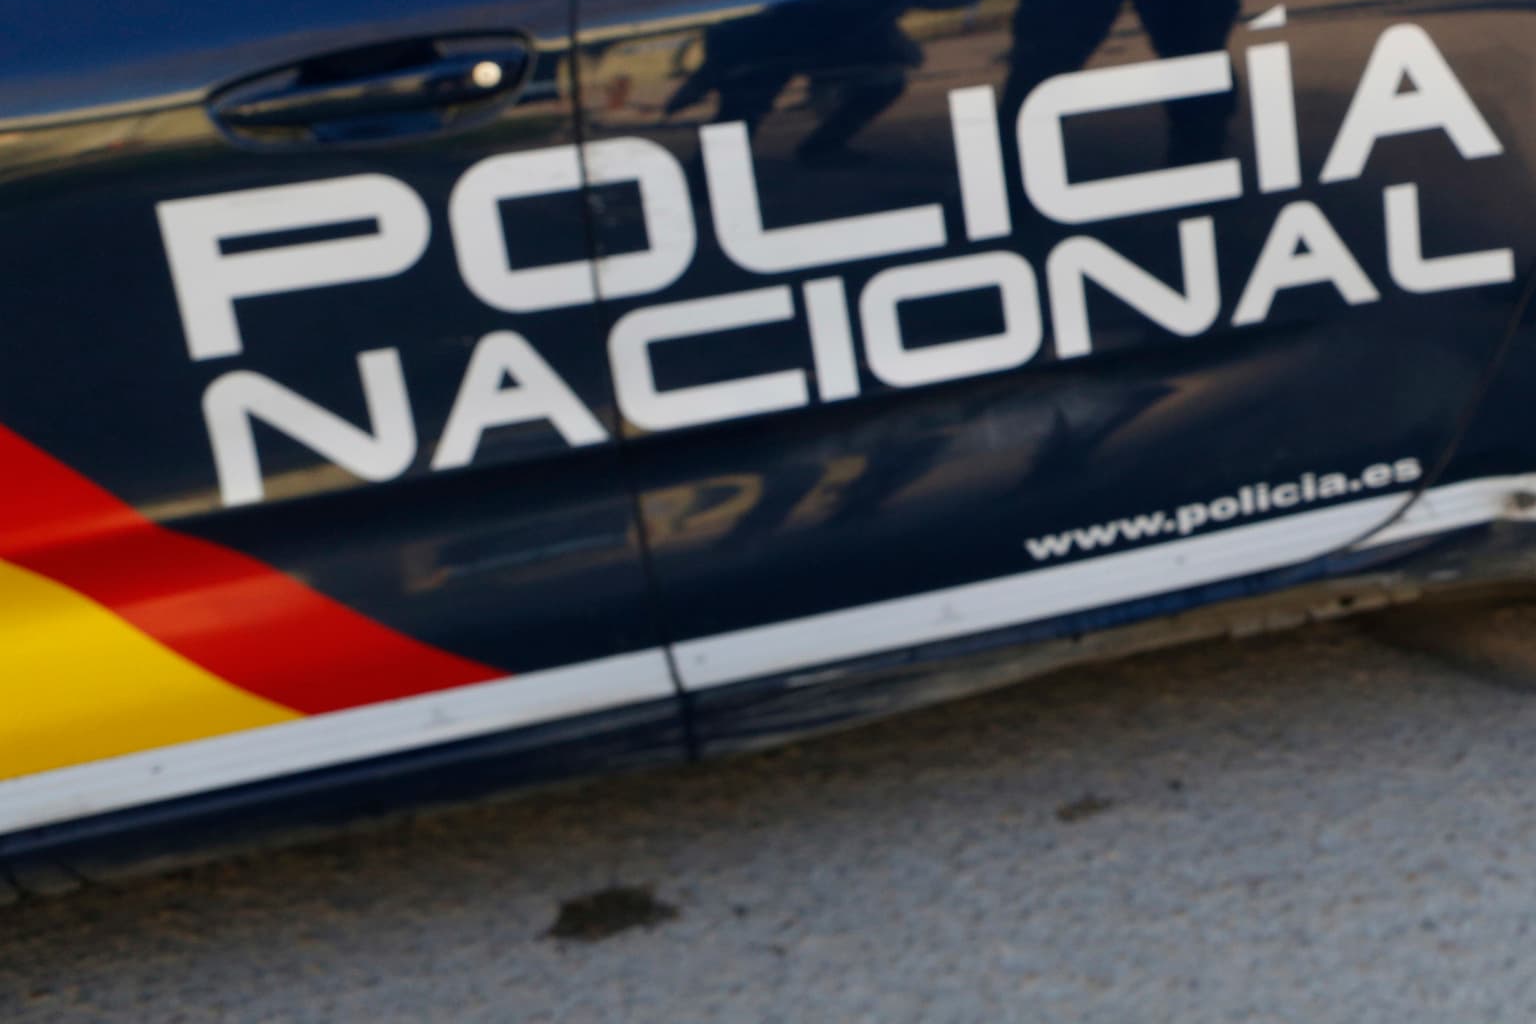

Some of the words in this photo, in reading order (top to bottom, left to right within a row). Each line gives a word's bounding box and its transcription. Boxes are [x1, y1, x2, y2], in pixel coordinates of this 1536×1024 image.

[156, 4, 1504, 362] POLICÍA
[202, 183, 1515, 508] NACIONAL
[1024, 456, 1423, 561] www.policia.es
